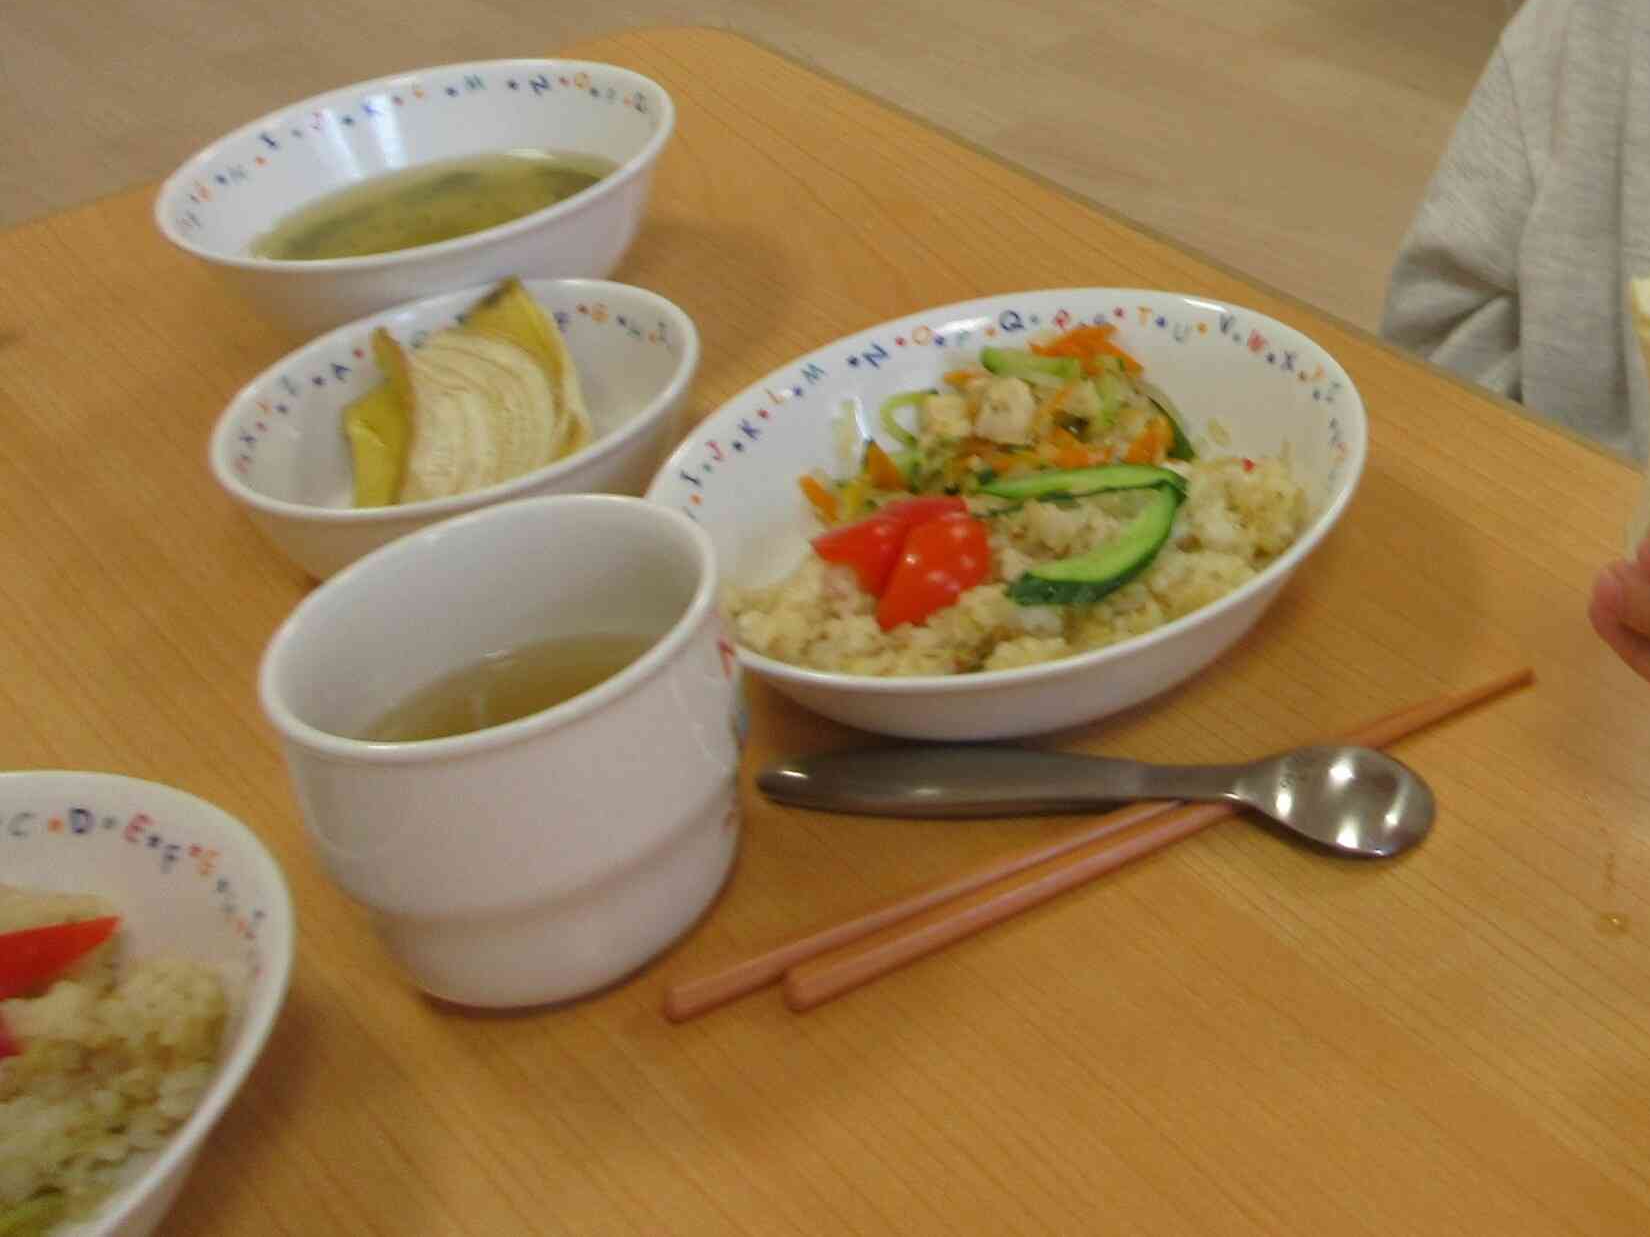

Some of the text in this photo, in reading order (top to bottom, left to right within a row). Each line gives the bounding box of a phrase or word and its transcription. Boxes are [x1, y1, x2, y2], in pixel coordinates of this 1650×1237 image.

[737, 417, 761, 442] K
[860, 341, 889, 369] N
[998, 308, 1025, 333] Q
[69, 808, 95, 834] D
